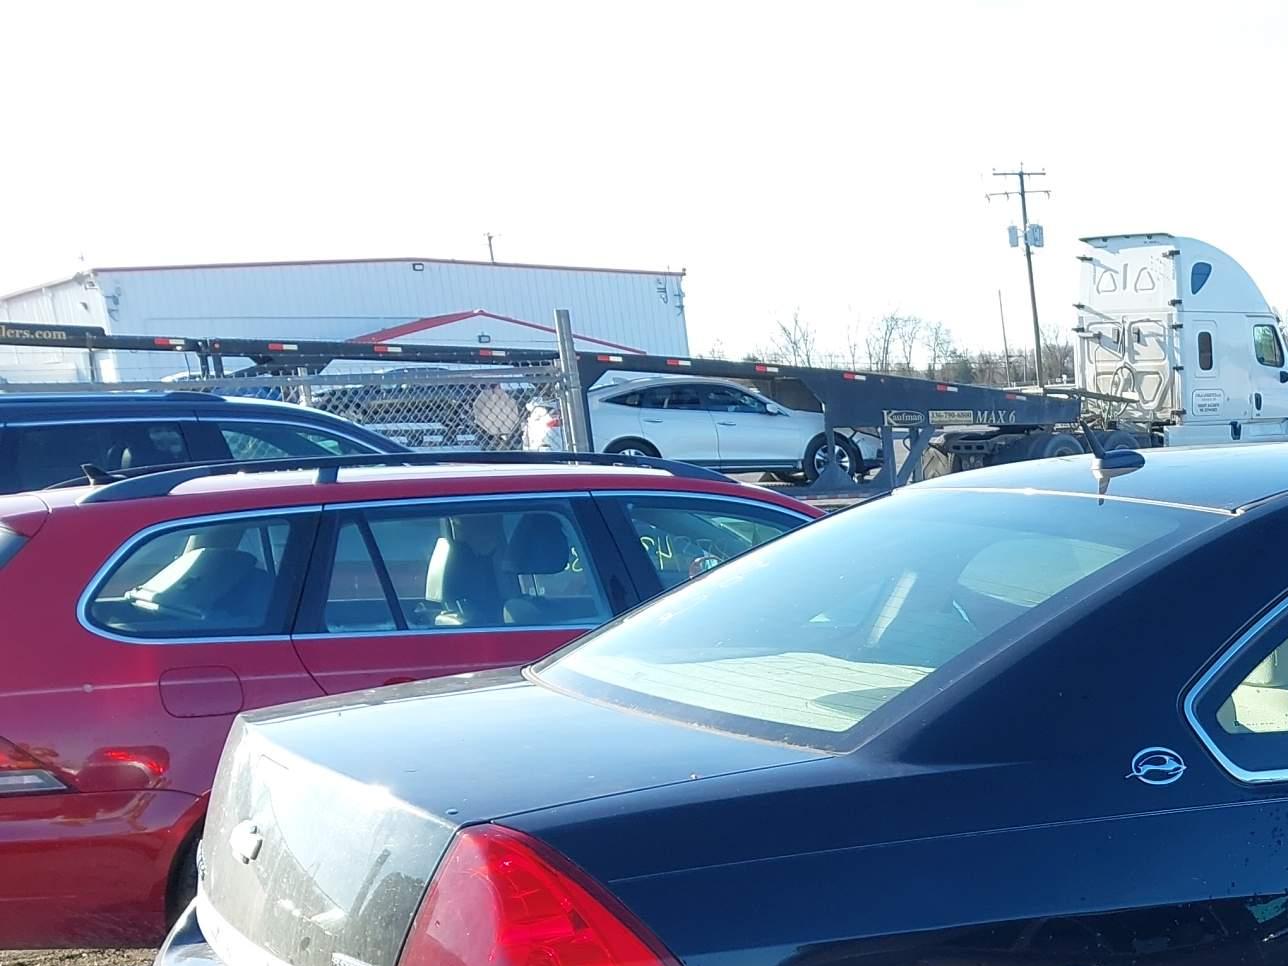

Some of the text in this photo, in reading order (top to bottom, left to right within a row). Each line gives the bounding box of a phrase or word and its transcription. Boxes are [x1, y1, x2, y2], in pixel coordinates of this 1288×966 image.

[882, 410, 923, 426] Kaufman
[976, 410, 1007, 424] MAX
[1008, 410, 1016, 424] 6
